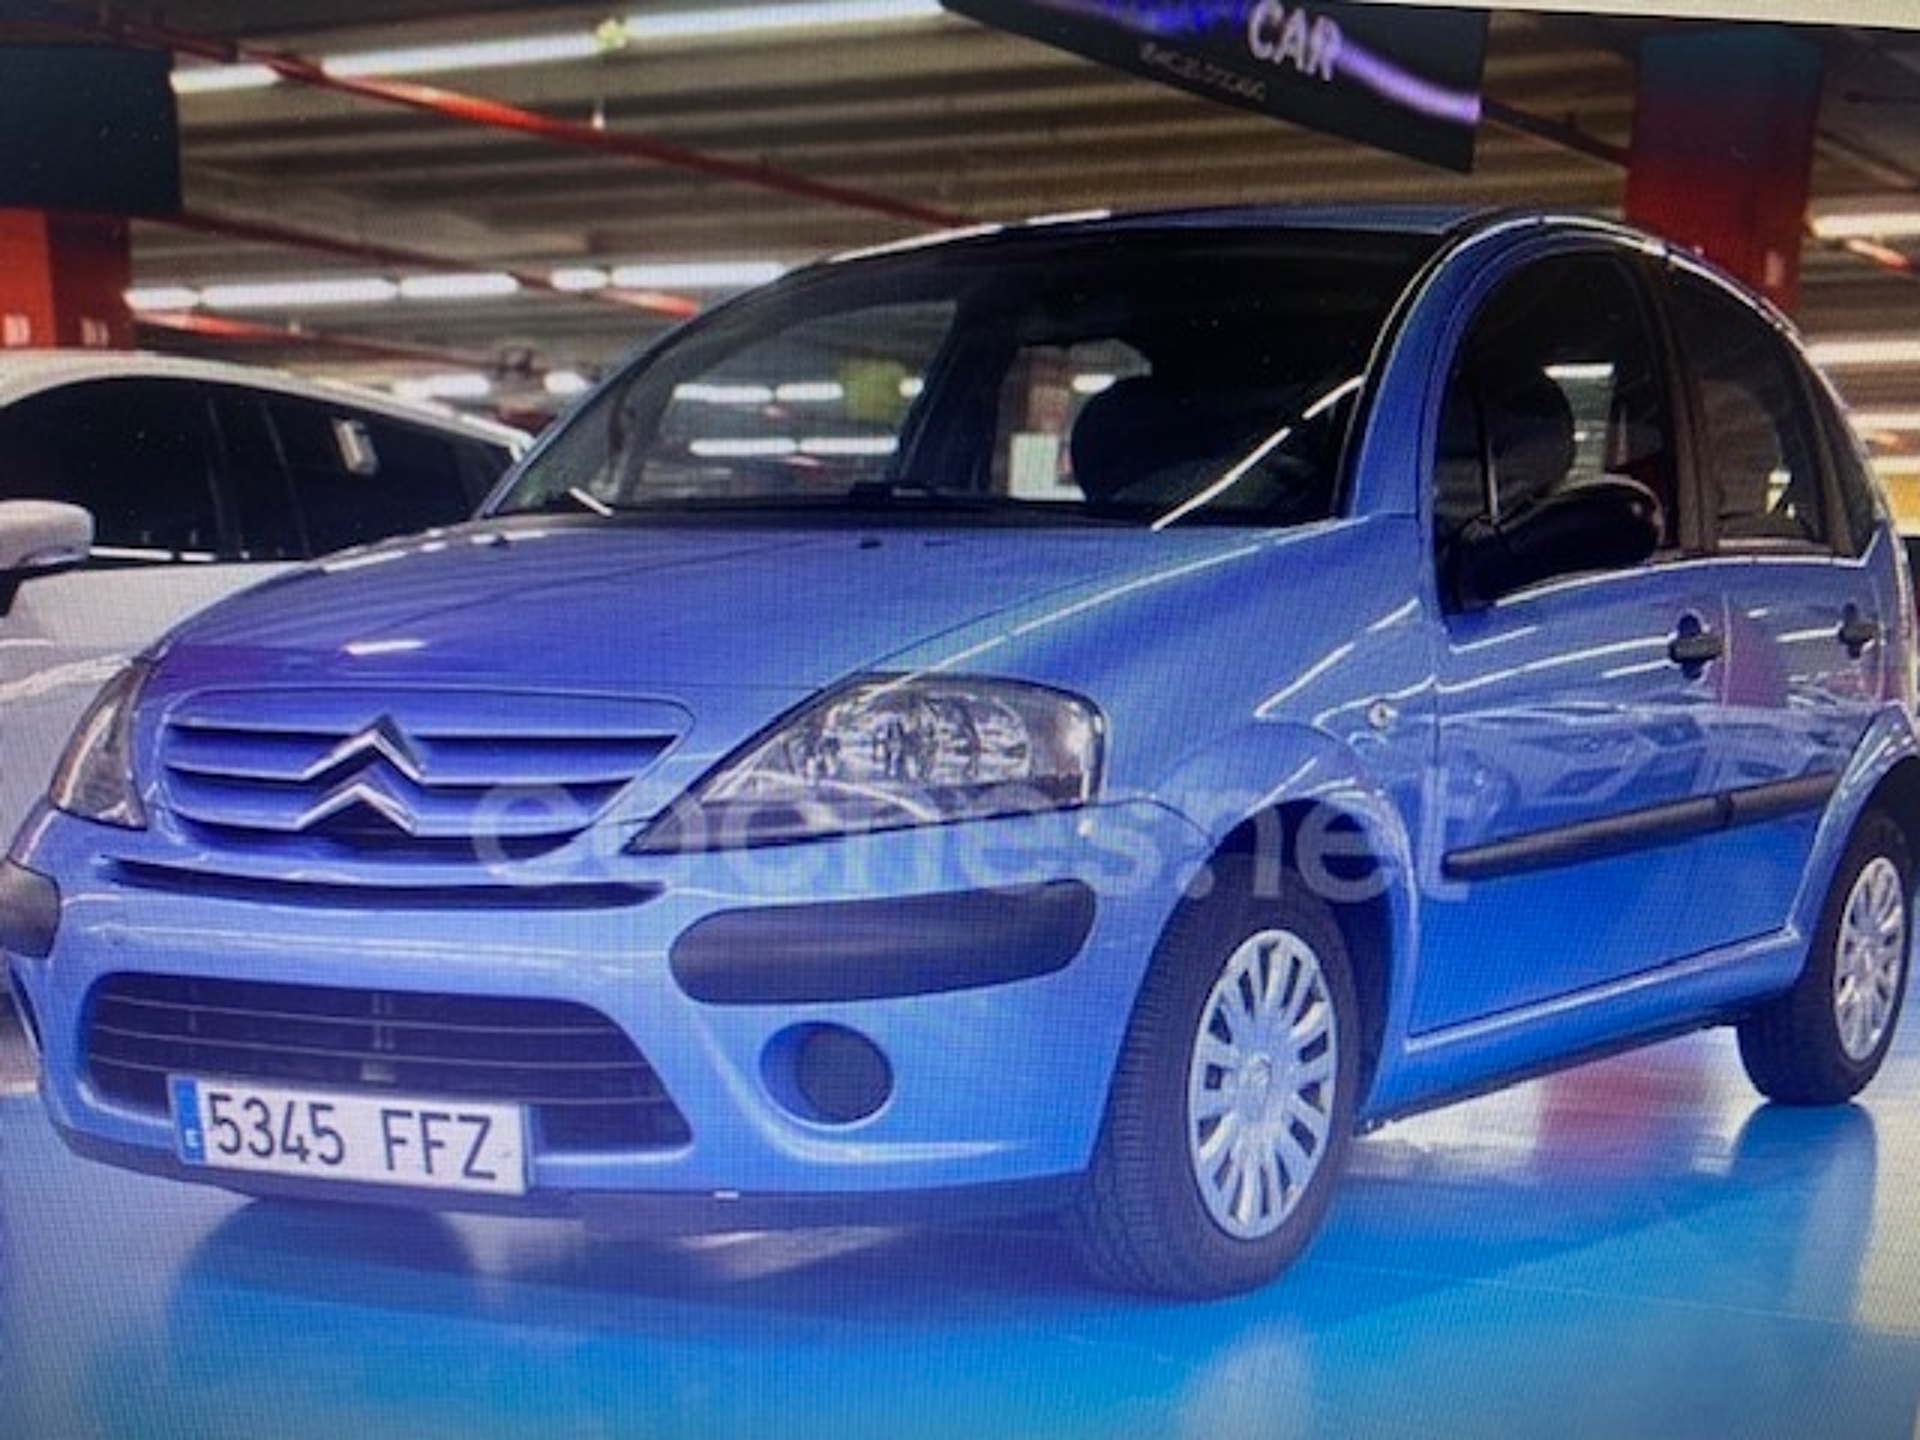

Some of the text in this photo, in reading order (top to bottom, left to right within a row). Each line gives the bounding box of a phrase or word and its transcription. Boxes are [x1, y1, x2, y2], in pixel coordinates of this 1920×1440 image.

[1247, 0, 1343, 82] CAR
[208, 1092, 497, 1181] 5345 FFZ
